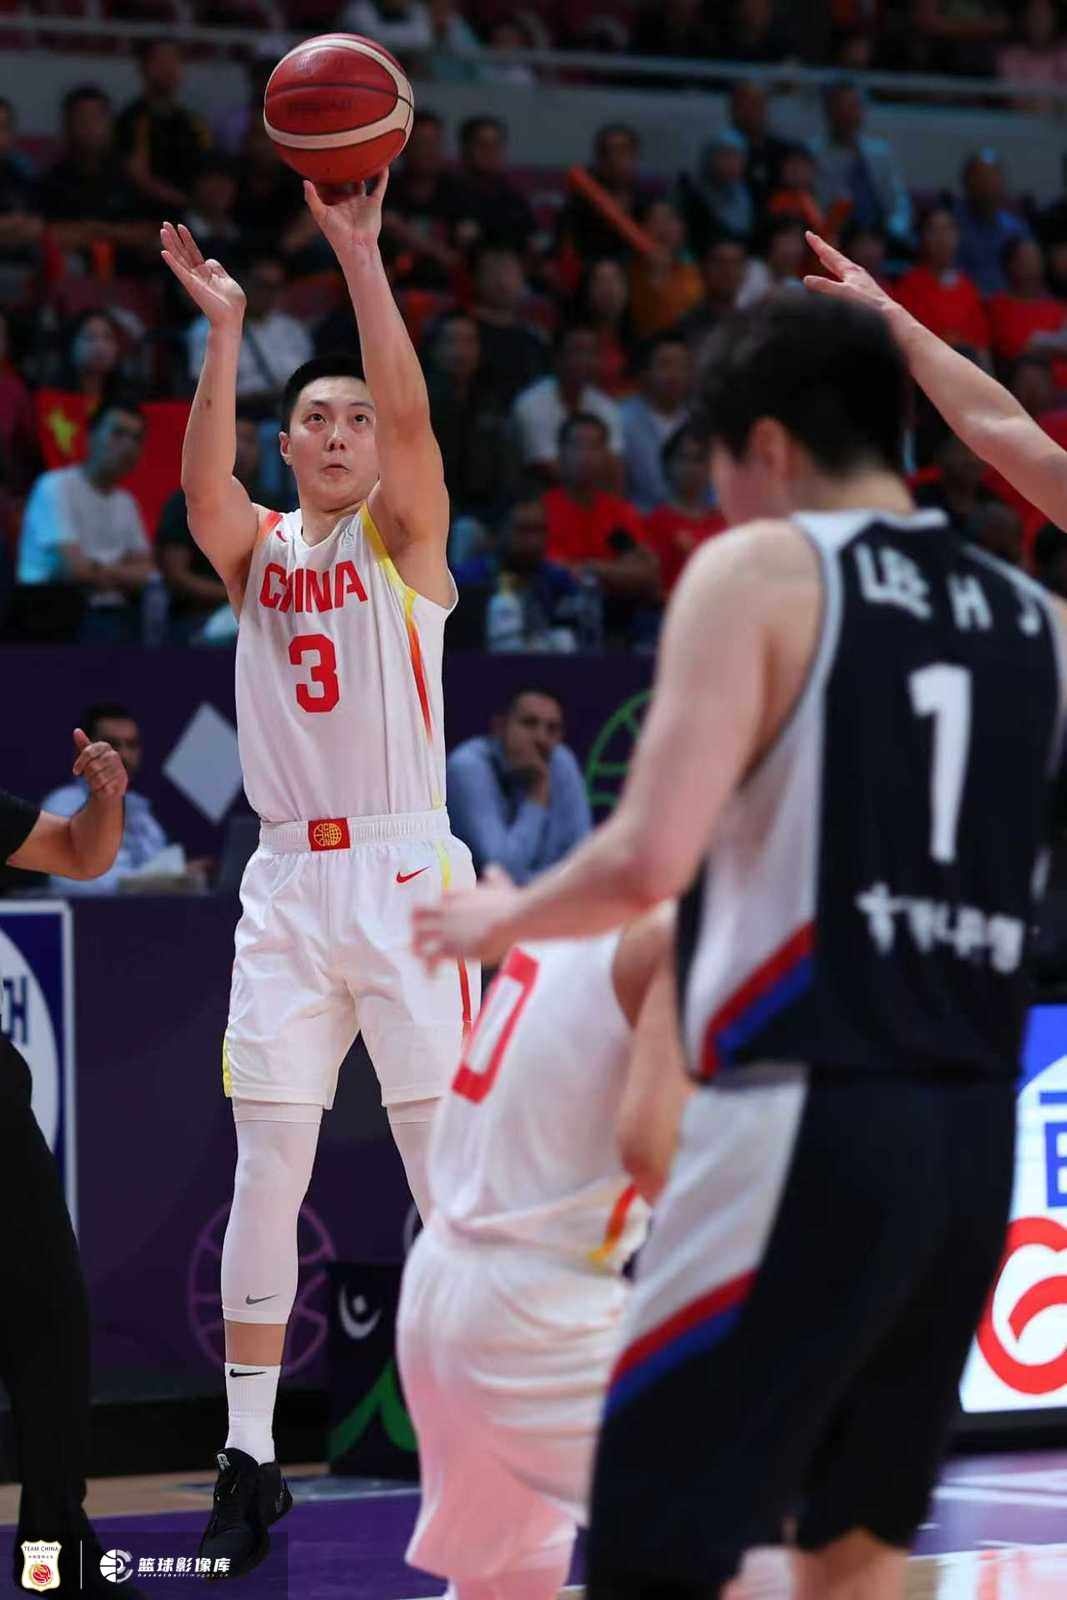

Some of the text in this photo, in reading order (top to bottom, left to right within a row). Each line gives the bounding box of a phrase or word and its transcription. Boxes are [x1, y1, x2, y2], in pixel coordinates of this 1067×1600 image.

[259, 560, 369, 613] CHINA
[947, 573, 993, 631] H
[288, 633, 340, 713] 3
[909, 662, 973, 863] 1
[451, 947, 540, 1104] 0
